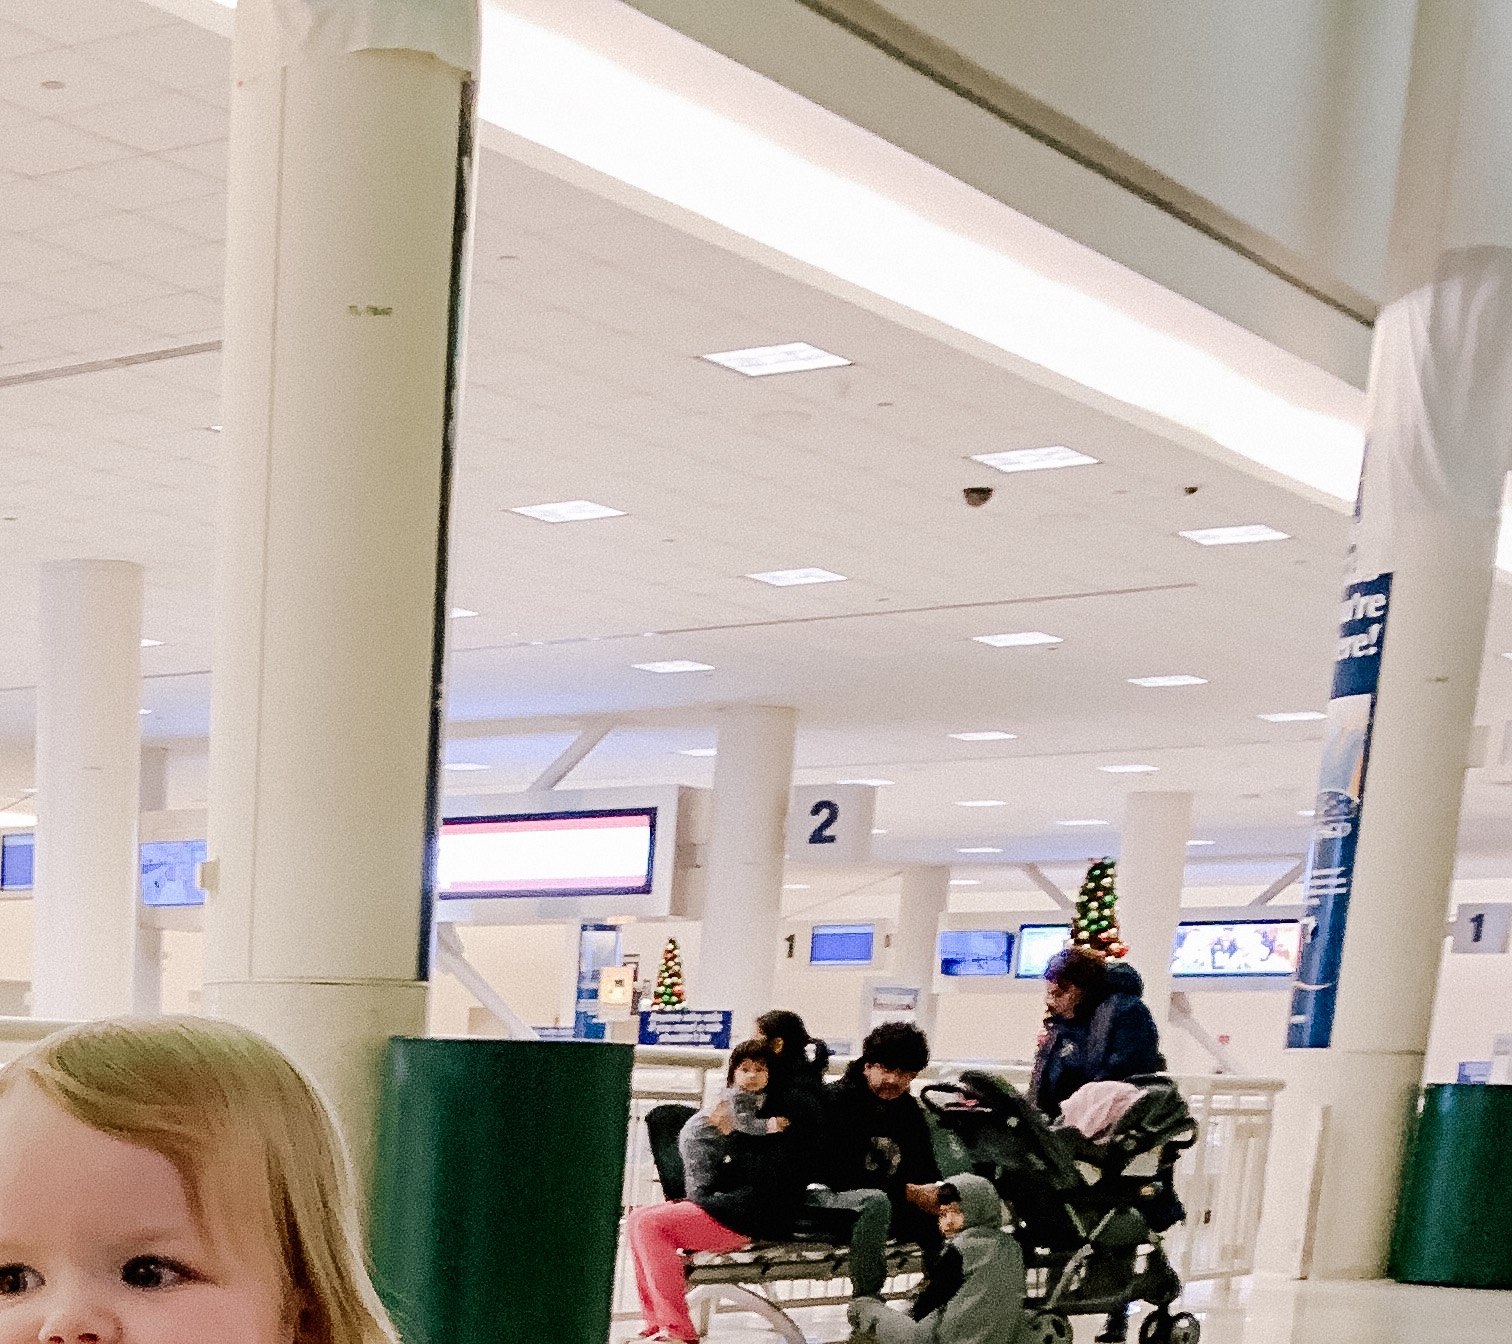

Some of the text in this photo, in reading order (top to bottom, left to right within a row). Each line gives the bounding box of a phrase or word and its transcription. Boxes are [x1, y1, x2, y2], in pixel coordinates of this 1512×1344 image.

[808, 800, 839, 844] 2
[1469, 913, 1485, 943] 1
[784, 933, 796, 959] 1
